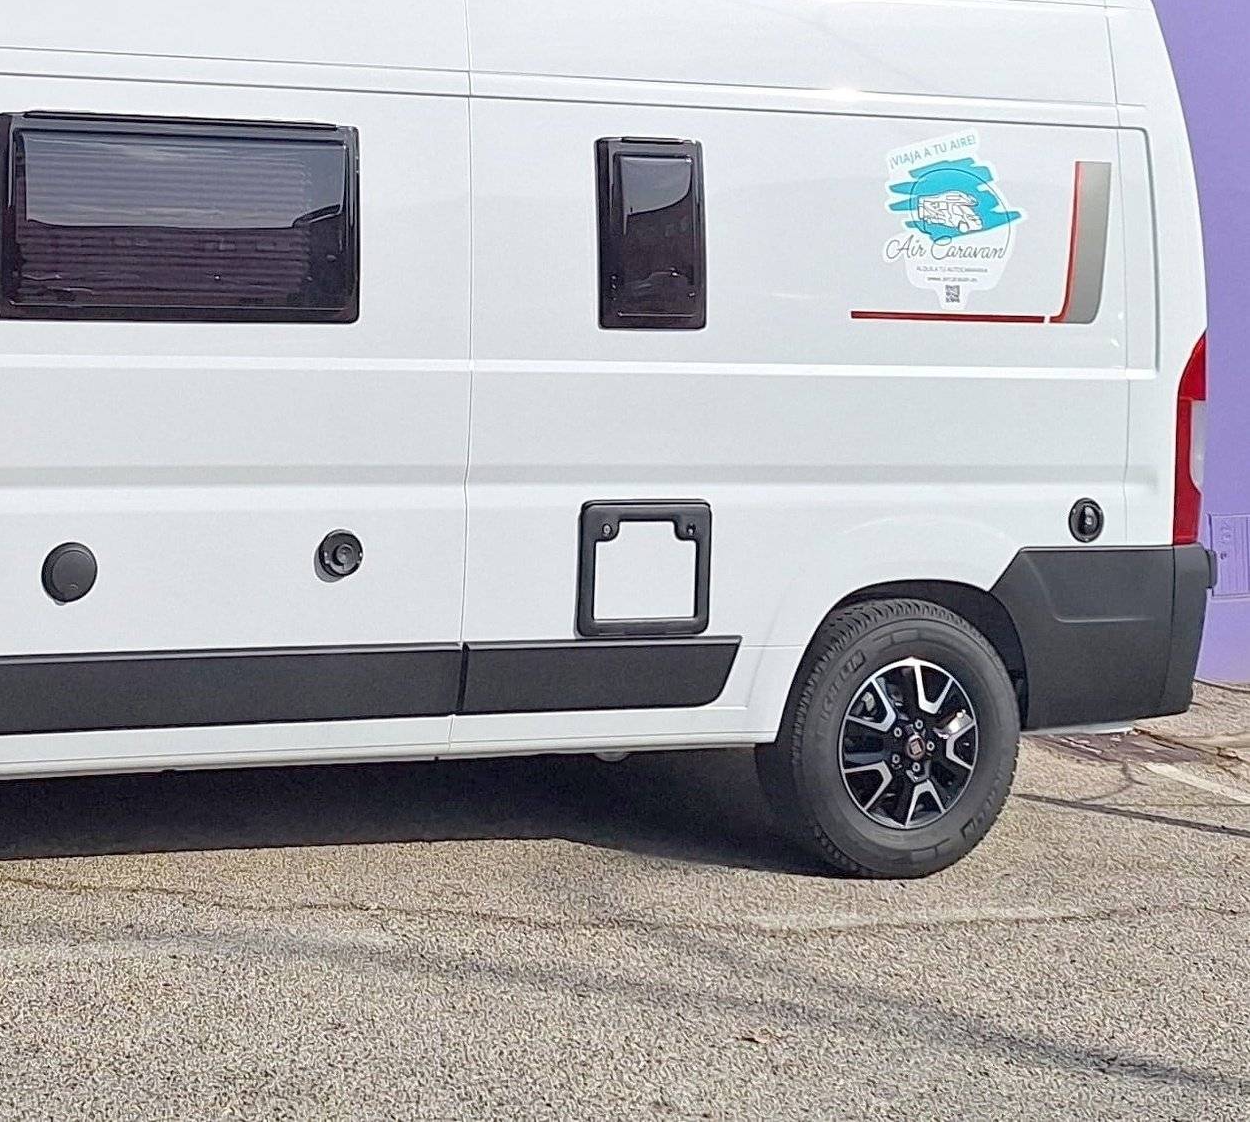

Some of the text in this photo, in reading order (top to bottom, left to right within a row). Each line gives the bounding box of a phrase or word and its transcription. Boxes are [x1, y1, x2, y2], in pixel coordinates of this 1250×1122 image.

[924, 146, 932, 158] A
[933, 141, 948, 154] TU
[886, 234, 1006, 260] Air Caravan
